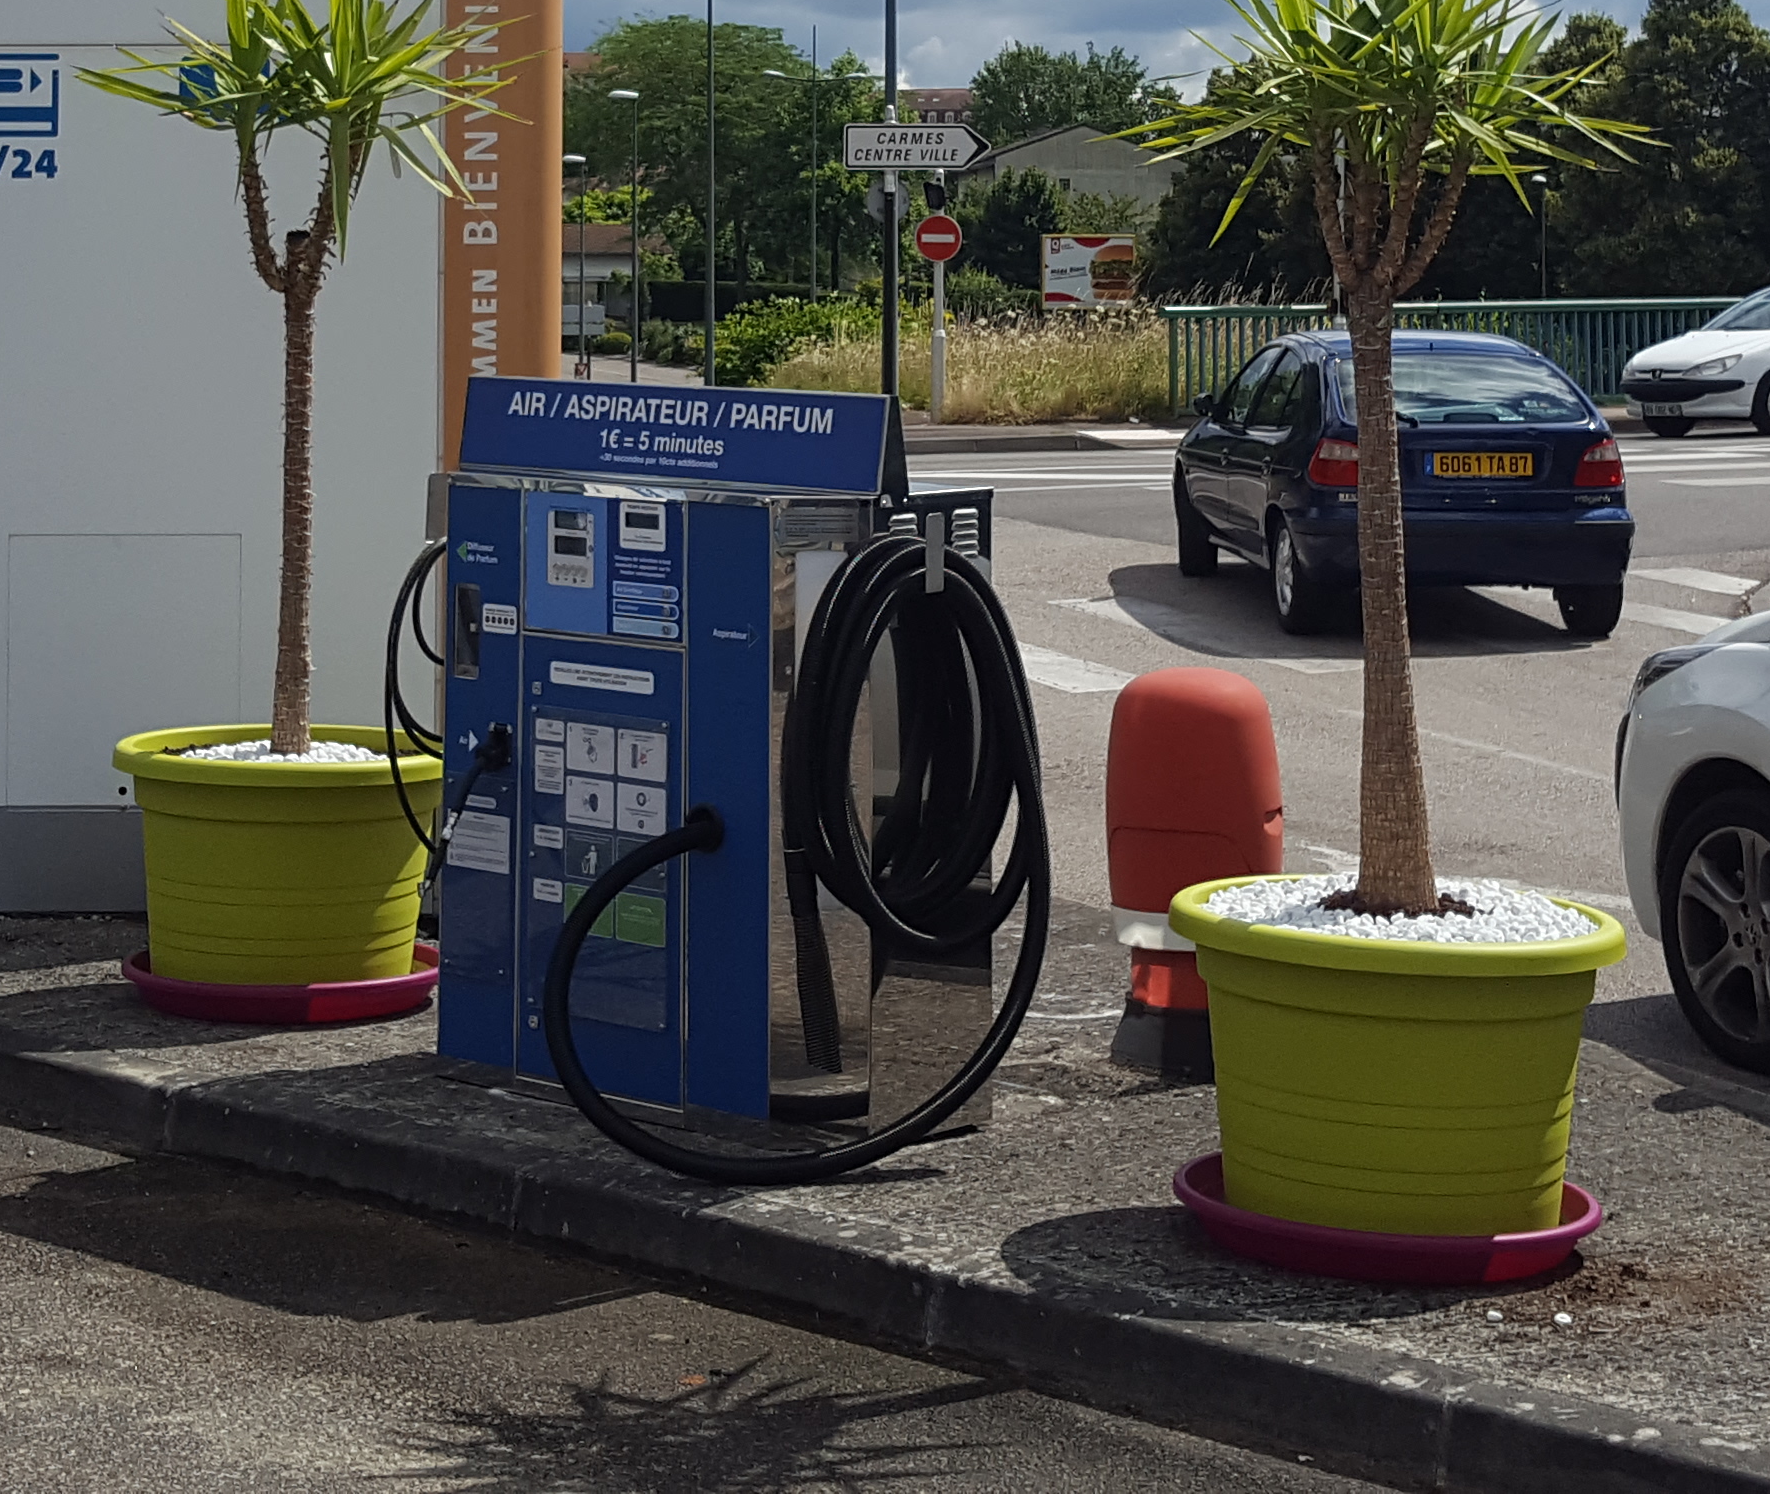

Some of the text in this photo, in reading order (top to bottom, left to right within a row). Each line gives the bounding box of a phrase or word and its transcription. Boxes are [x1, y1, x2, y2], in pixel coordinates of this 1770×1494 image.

[876, 132, 945, 145] CARMES
[854, 149, 959, 162] CENTRE VILLE
[507, 391, 546, 417] AIR
[564, 394, 709, 427] ASPIRATEUR
[729, 403, 834, 434] PARFUM
[598, 428, 620, 449] 1€
[639, 430, 650, 451] 5
[653, 431, 725, 456] minutes
[1439, 455, 1529, 474] 6061 TA 87
